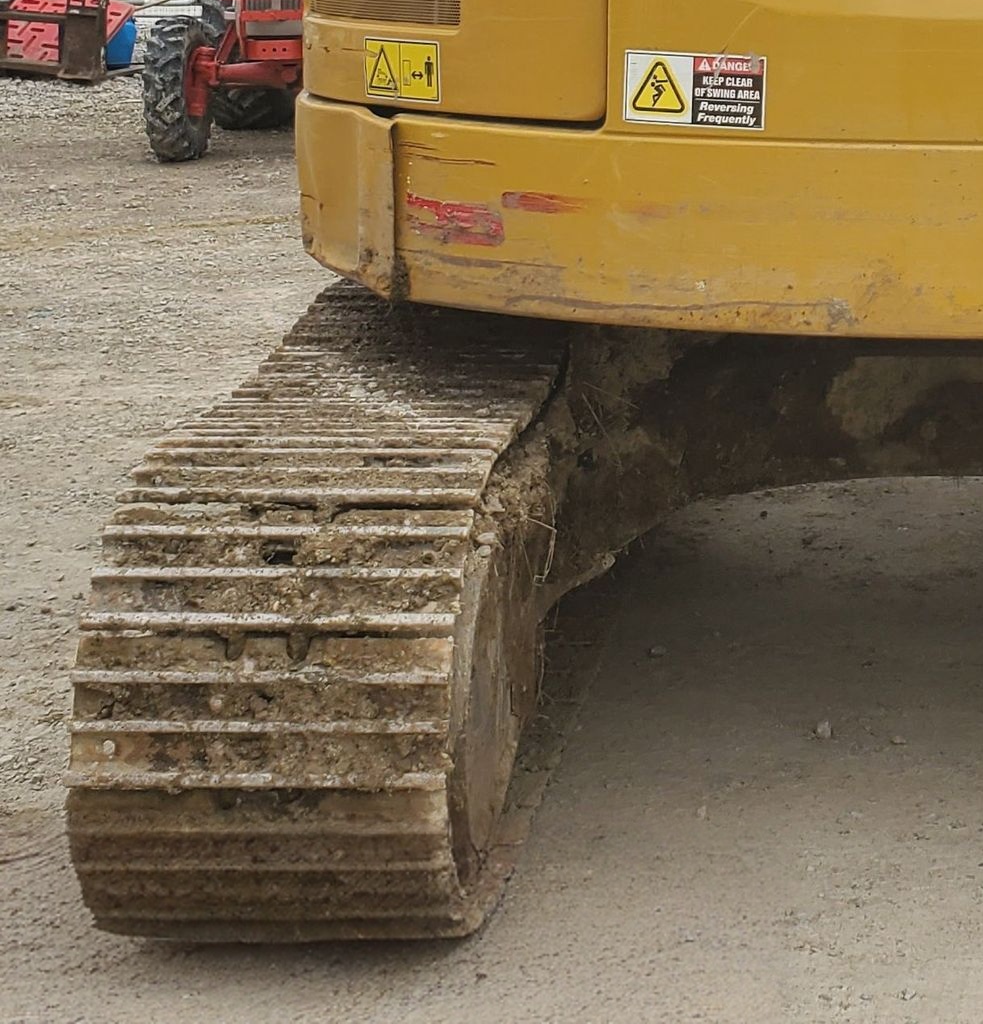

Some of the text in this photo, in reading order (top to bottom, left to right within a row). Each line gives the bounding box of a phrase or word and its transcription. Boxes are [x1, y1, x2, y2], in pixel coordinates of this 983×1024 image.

[712, 60, 753, 72] DANGE
[702, 76, 753, 87] KEEP CLEAR
[694, 88, 760, 100] OF SWING AREA
[699, 101, 755, 115] Reversing
[697, 112, 757, 127] Frequently
